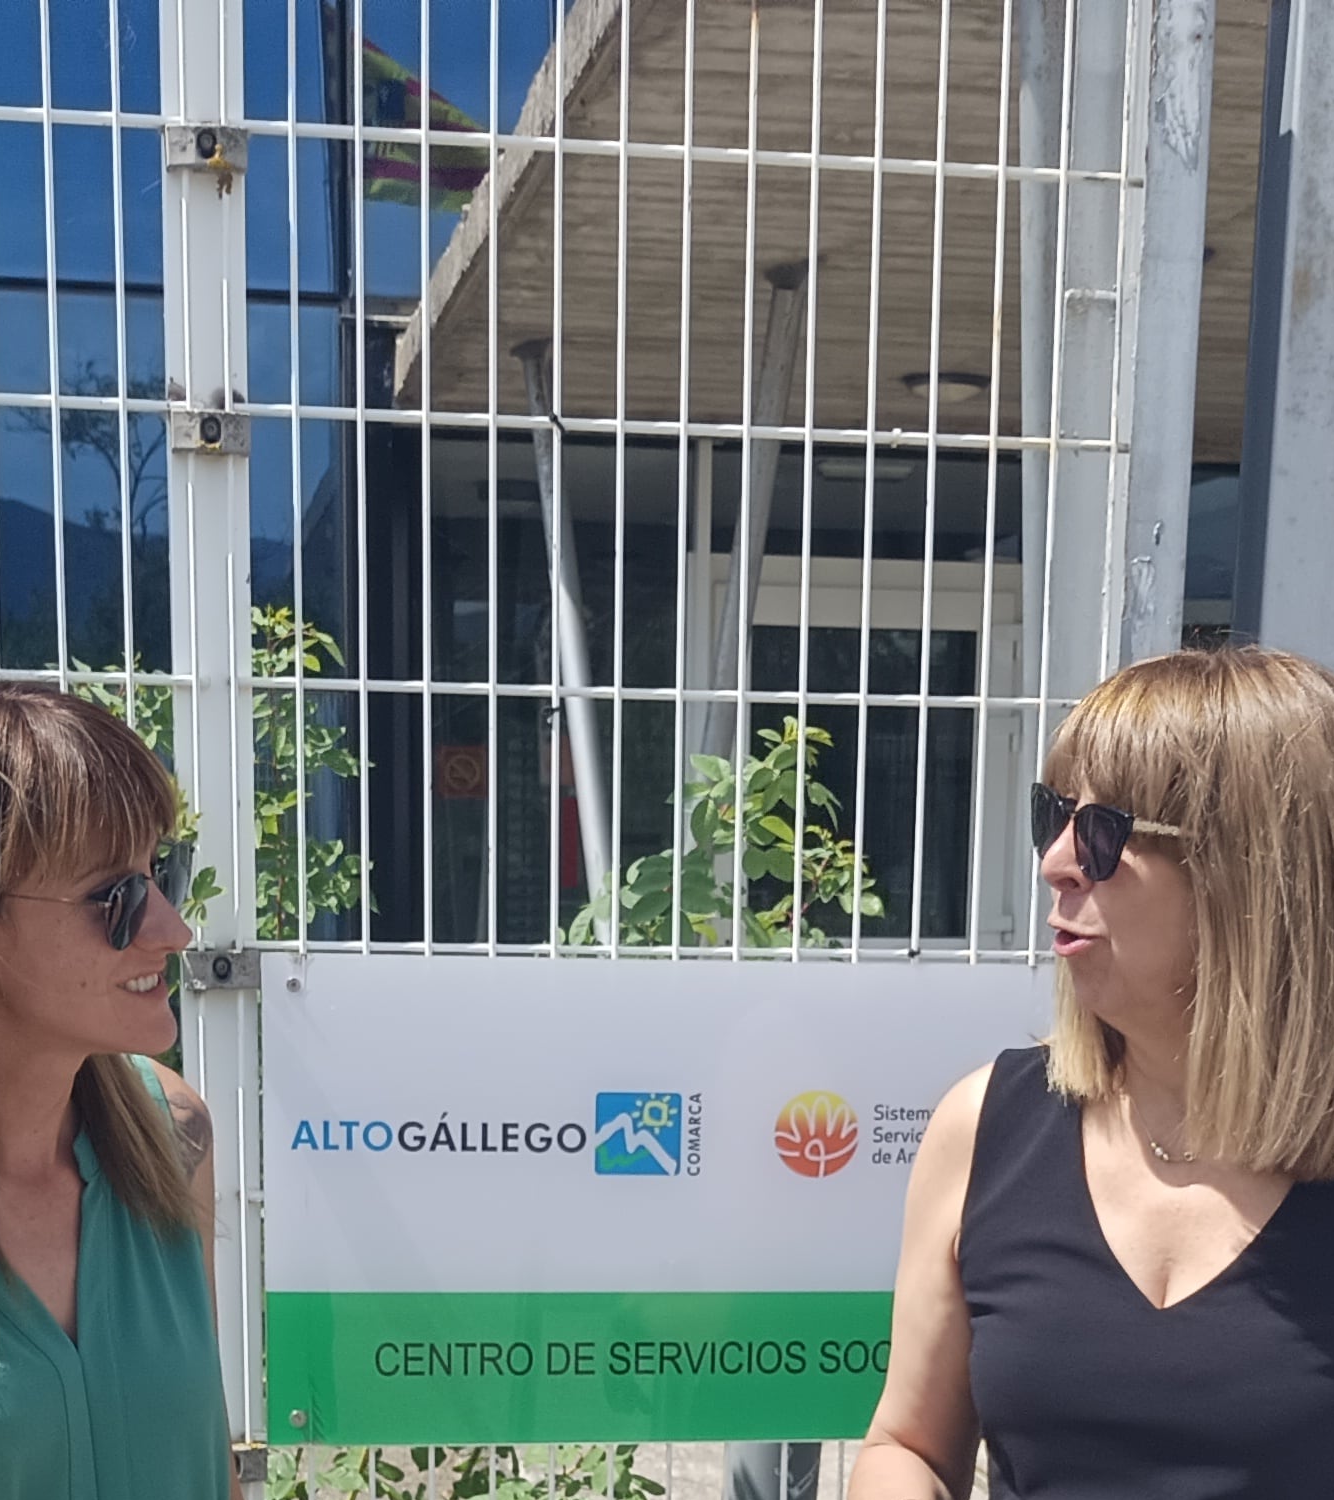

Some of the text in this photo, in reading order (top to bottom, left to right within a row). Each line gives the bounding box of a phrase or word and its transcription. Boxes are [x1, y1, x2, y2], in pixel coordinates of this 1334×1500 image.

[873, 1104, 933, 1121] Sistem
[686, 1092, 703, 1177] COMARCA
[872, 1126, 924, 1143] Servic
[871, 1147, 917, 1164] de Ar
[374, 1340, 891, 1377] CENTRO DE SERVICIOS SOC
